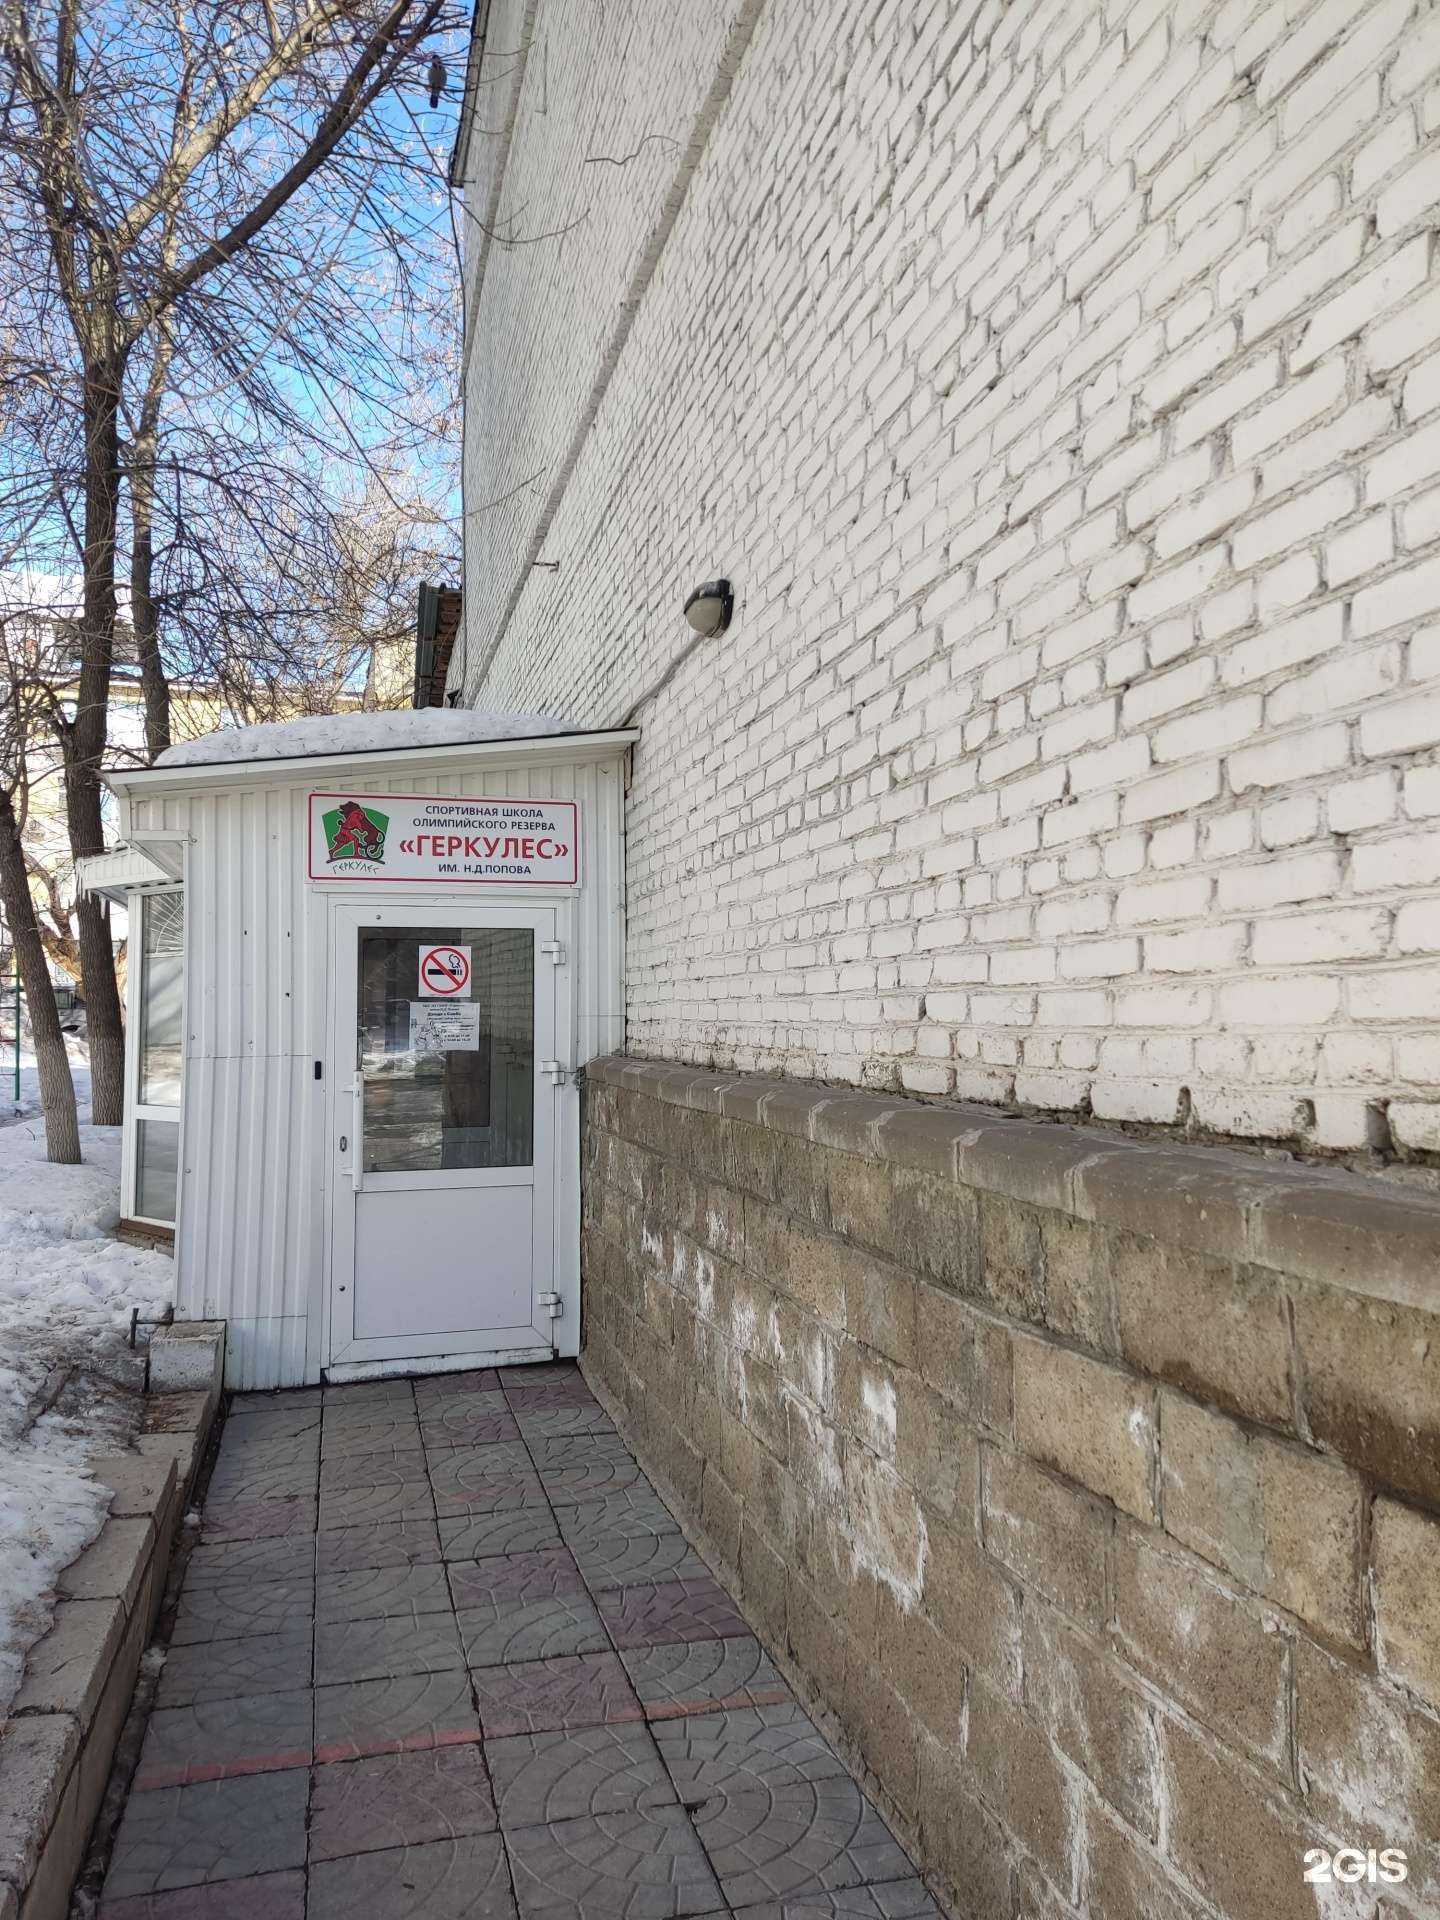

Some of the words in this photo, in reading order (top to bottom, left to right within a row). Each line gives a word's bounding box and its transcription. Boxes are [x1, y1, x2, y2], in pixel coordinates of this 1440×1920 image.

[425, 805, 499, 817] СПОРТИВНАЯ
[502, 807, 543, 818] ШКОЛА
[412, 817, 508, 830] ОЛИМПИЙСКОГО
[511, 820, 555, 831] РЕЗЕРВА
[399, 835, 569, 859] «ГЕРКУЛЕС»
[438, 864, 461, 873] ИМ.
